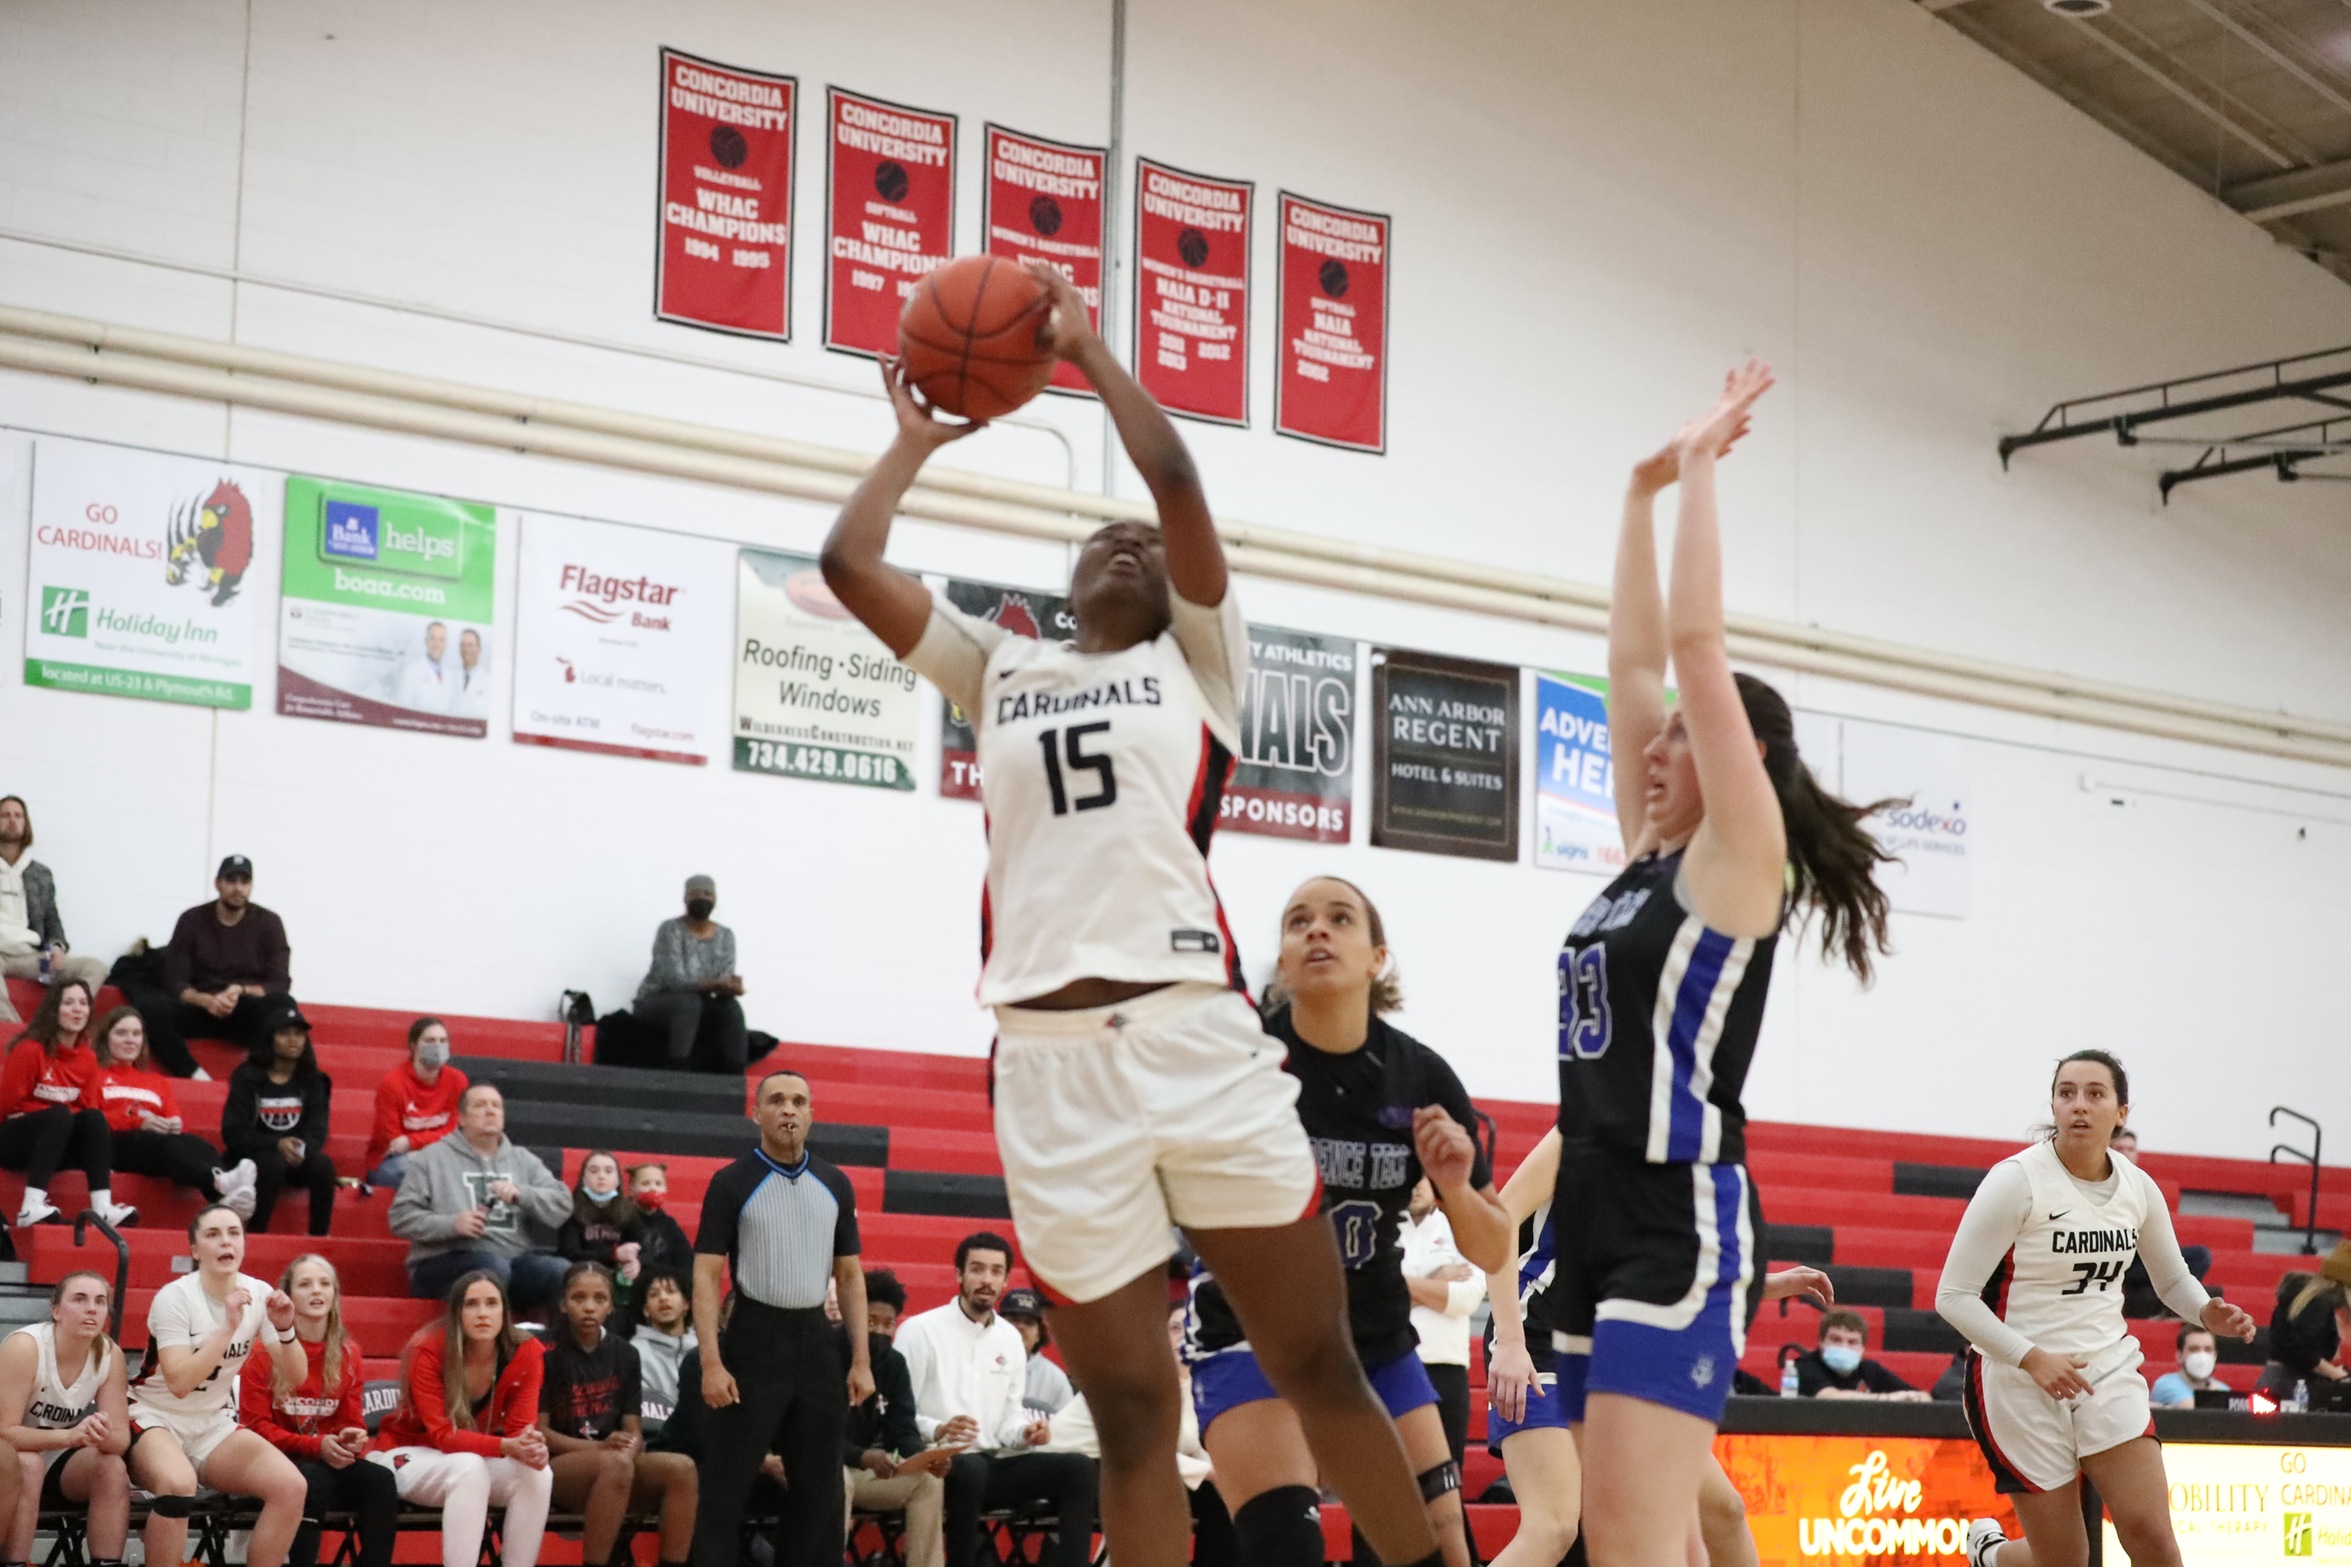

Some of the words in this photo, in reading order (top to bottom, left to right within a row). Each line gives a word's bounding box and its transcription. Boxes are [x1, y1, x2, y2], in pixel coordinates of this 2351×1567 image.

[675, 64, 784, 109] CONCORDIA
[671, 86, 787, 132] UNIVERSITY
[840, 101, 944, 145] CONCORDIA
[837, 123, 948, 167] UNIVERSITY
[998, 138, 1096, 179] CONCORDIA
[994, 158, 1100, 200] UNIVERSITY
[1148, 172, 1241, 212] CONCORDIA
[696, 187, 759, 220] WHAC
[1143, 192, 1244, 233] UNIVERSITY
[666, 201, 787, 245] CHAMPIONS
[862, 220, 922, 254] WHAC
[1290, 205, 1379, 244] CONCORDIA
[684, 236, 720, 263] 1994
[1287, 225, 1383, 265] UNIVERSITY
[1156, 276, 1196, 304] NAIA
[1150, 308, 1237, 341] TOURNAMENT
[1162, 298, 1225, 326] NATIONAL
[1314, 311, 1352, 337] NAIA
[1292, 338, 1375, 370] TOURNAMENT
[1303, 328, 1364, 354] NATIONAL
[85, 503, 118, 525] GO
[37, 526, 163, 560] CARDINALS!
[333, 524, 371, 545] Bank
[385, 521, 454, 561] helps
[335, 568, 446, 605] boaa.com
[560, 564, 678, 606] Flagstar
[96, 607, 182, 644] Holiday
[184, 619, 218, 643] Inn
[631, 612, 671, 632] Bank
[743, 638, 833, 681] Roofing
[847, 653, 918, 692] Siding
[1264, 644, 1353, 672] ATHLETICS
[42, 664, 89, 685] located
[90, 671, 103, 685] at
[105, 673, 141, 689] US-23
[155, 678, 213, 697] Plymouth
[581, 670, 613, 687] Local
[779, 680, 882, 717] Windows
[997, 677, 1161, 725] CARDINALS
[1389, 692, 1434, 715] ANN
[1436, 700, 1505, 726] ARBOR
[531, 709, 572, 727] On-site
[575, 716, 600, 729] ATM
[631, 722, 695, 742] flagstar.com
[1394, 716, 1501, 753] REGENT
[1540, 706, 1609, 753] ADVE
[747, 740, 897, 783] 734.429.0616
[950, 761, 984, 787] TH
[1039, 720, 1117, 816] 15
[1391, 762, 1438, 784] HOTEL
[1441, 768, 1451, 784] &
[1453, 770, 1503, 791] SUITES
[1220, 794, 1344, 831] SPONSORS
[1886, 808, 1967, 835] sodexo
[2052, 1228, 2138, 1254] CARDINALS
[2062, 1260, 2124, 1295] 34
[2280, 1452, 2306, 1474] GO
[1839, 1449, 1923, 1518] Live
[2169, 1483, 2269, 1512] OBILITY
[2210, 1519, 2268, 1535] THERAPY
